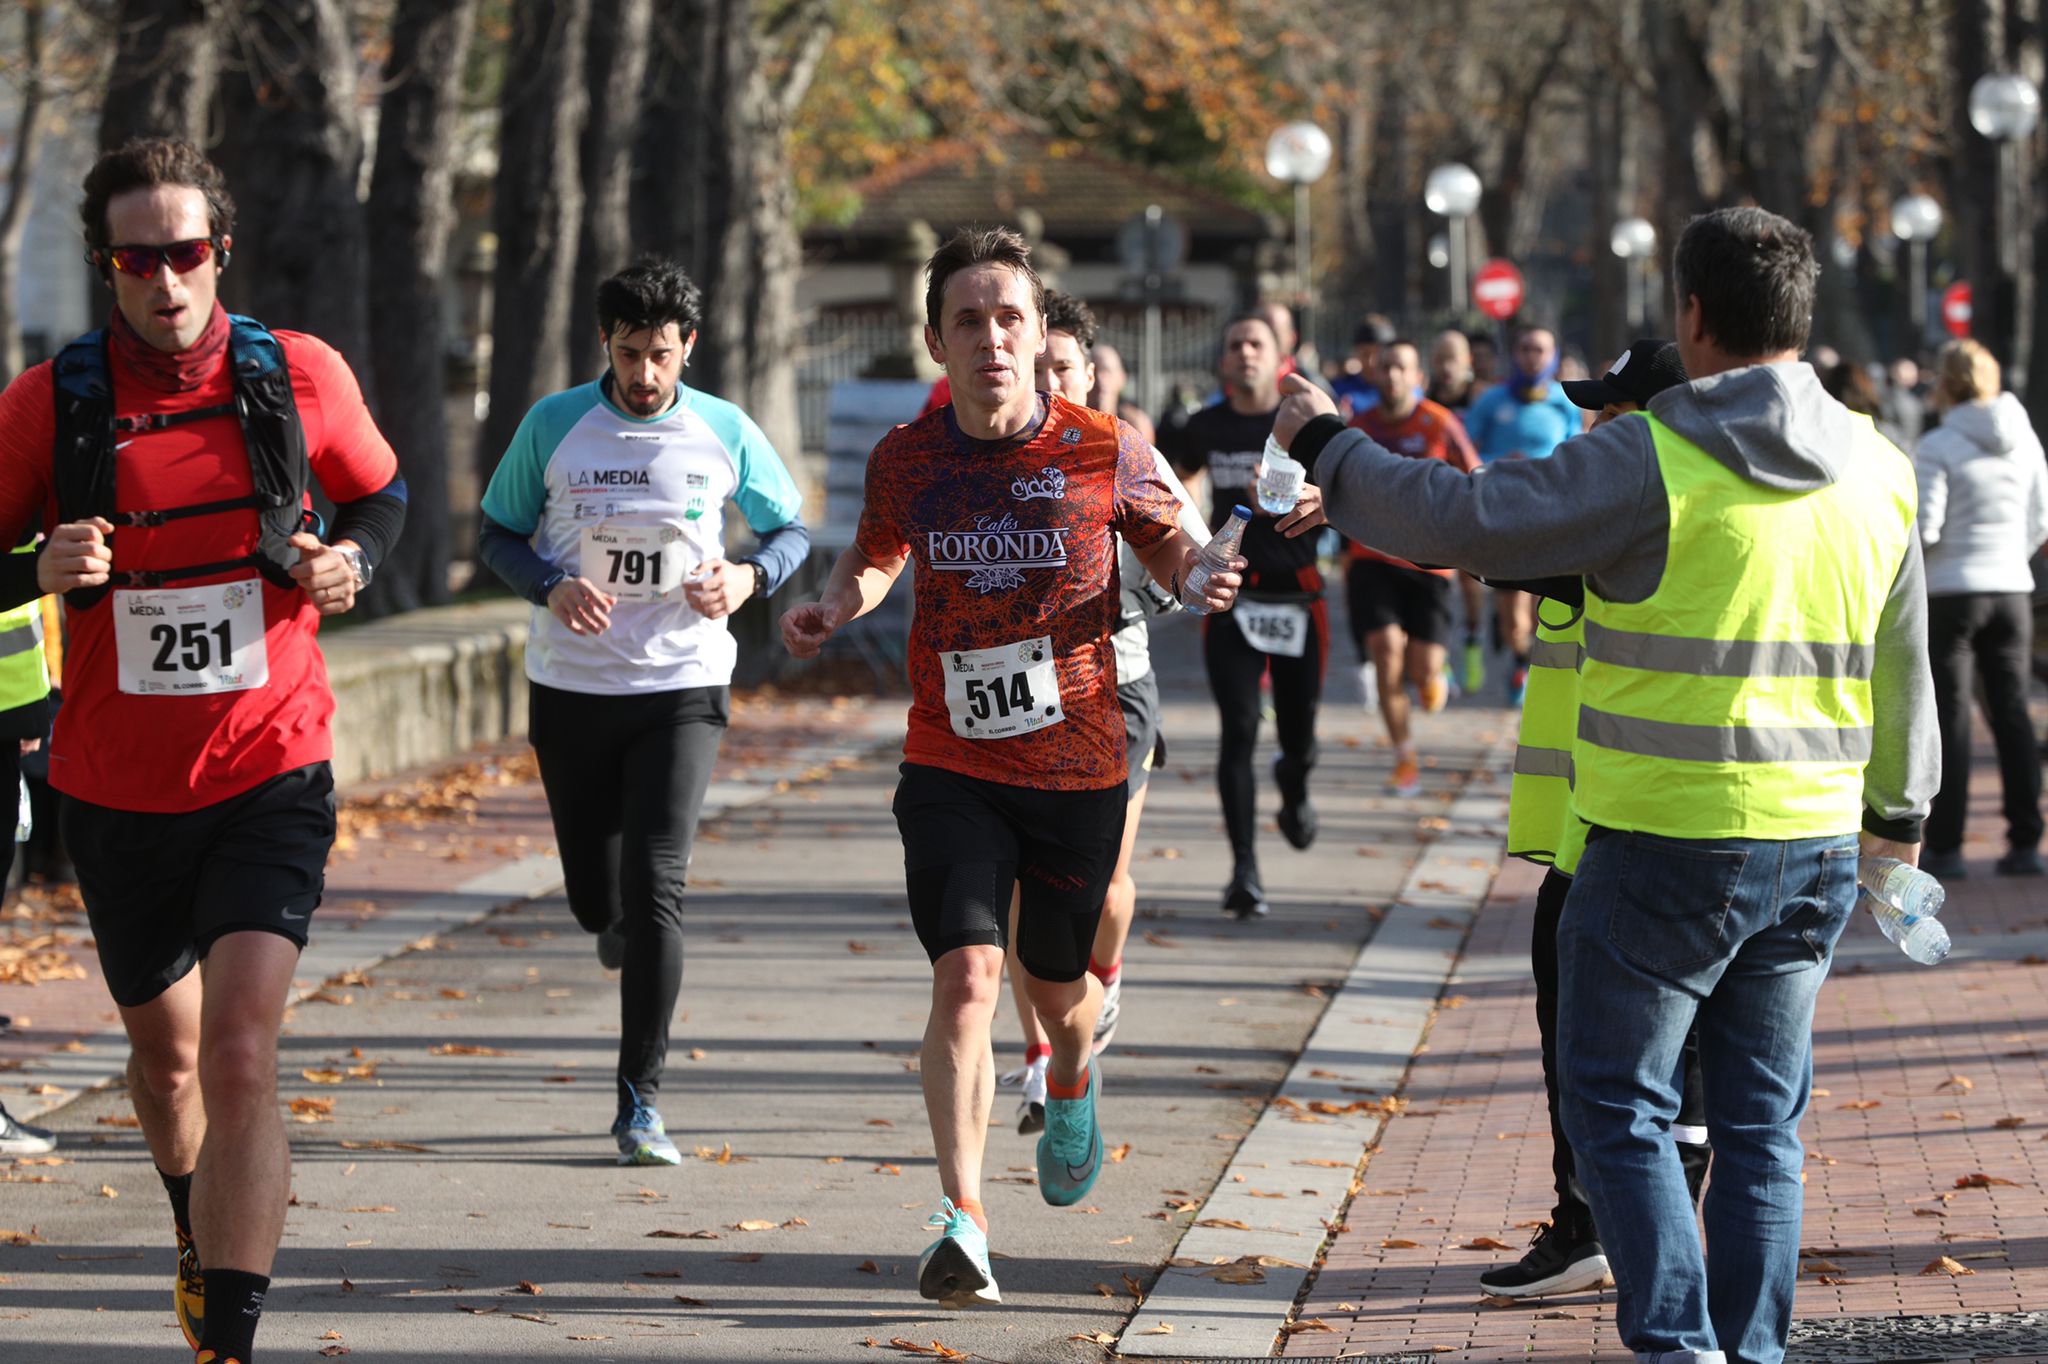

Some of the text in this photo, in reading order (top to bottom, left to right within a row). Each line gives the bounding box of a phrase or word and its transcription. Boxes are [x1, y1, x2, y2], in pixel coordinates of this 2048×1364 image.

[568, 470, 650, 487] LA MEDIA
[973, 512, 1018, 533] Cafés
[592, 534, 618, 543] MEDIA
[928, 532, 1067, 565] FORONDA
[606, 549, 662, 585] 791
[129, 606, 166, 616] MEDIA
[151, 619, 232, 672] 251
[953, 663, 975, 673] MEDIA
[965, 671, 1035, 720] 514
